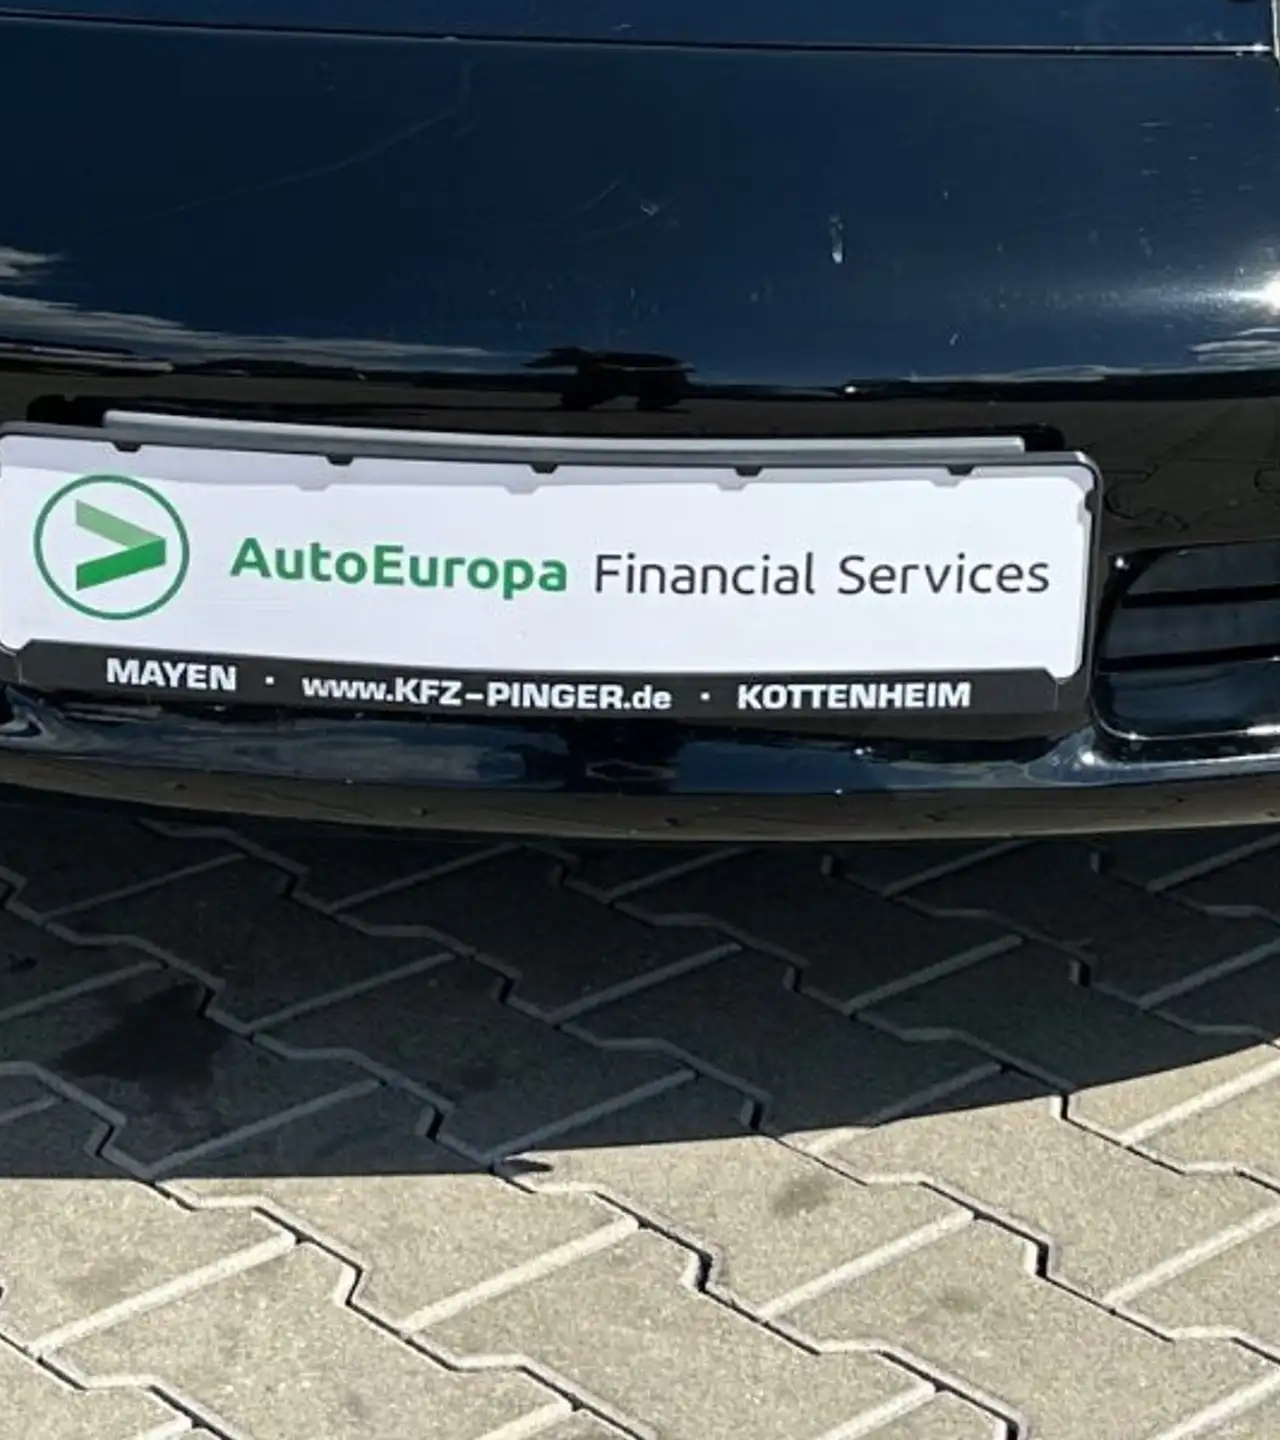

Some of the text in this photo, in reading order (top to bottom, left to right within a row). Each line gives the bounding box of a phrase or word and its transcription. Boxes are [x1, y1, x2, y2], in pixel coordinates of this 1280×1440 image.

[229, 536, 1051, 600] AutoEuropa Financial Services
[105, 656, 972, 710] MAYEN www.KFZ-PINGER.de KOTTENHEIM
